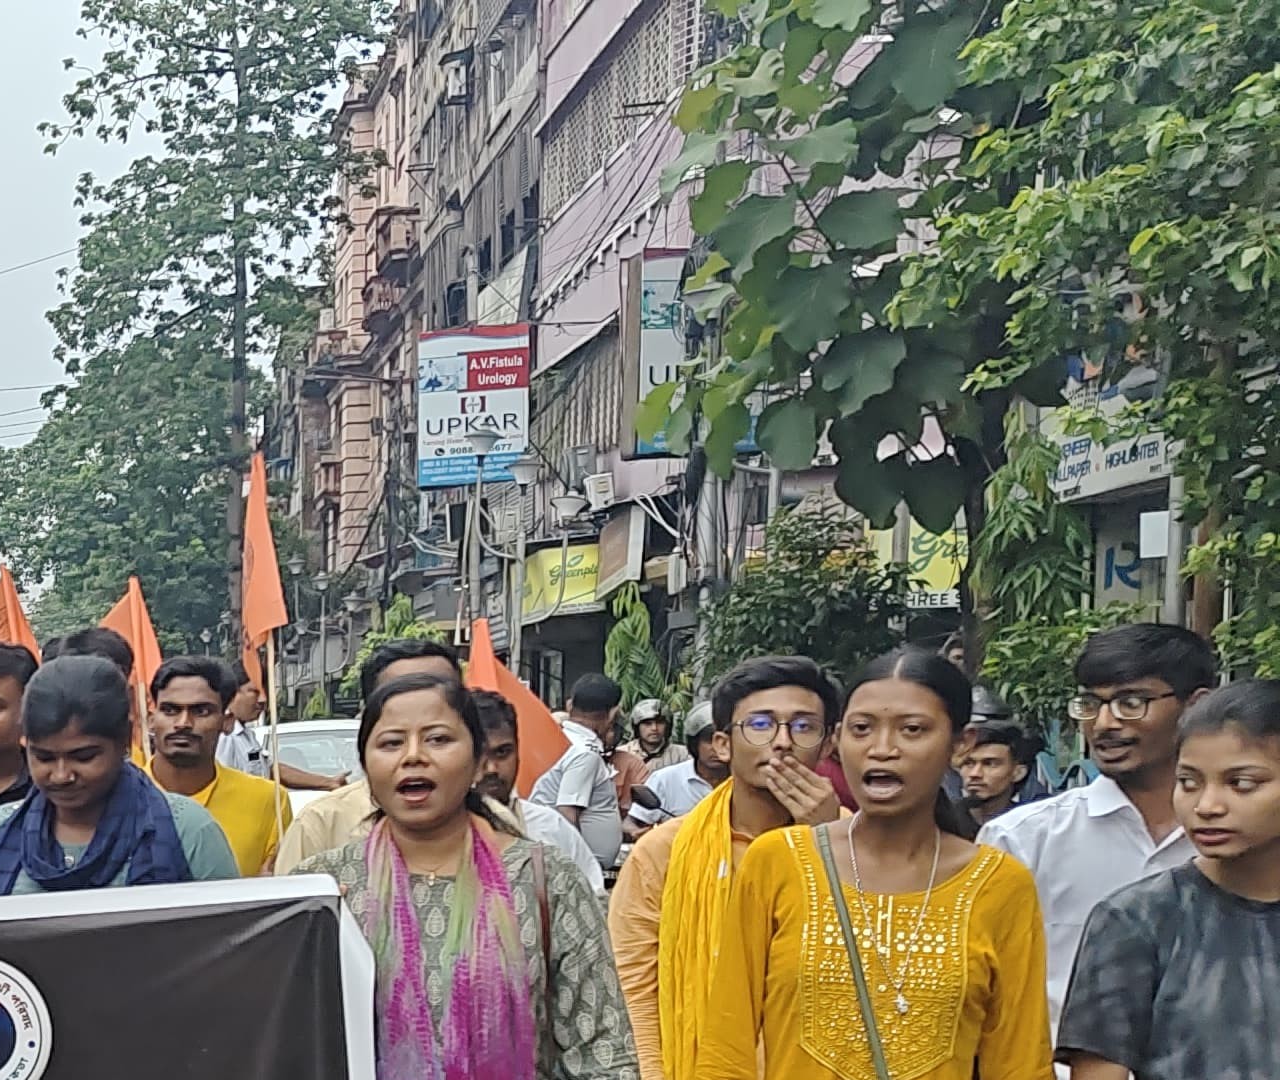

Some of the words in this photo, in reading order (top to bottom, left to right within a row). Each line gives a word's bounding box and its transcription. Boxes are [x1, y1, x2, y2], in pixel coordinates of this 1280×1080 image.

[469, 355, 523, 370] A.V.Fistula
[477, 372, 518, 386] Urology
[425, 413, 520, 436] UPKAR
[905, 593, 949, 606] HREE
